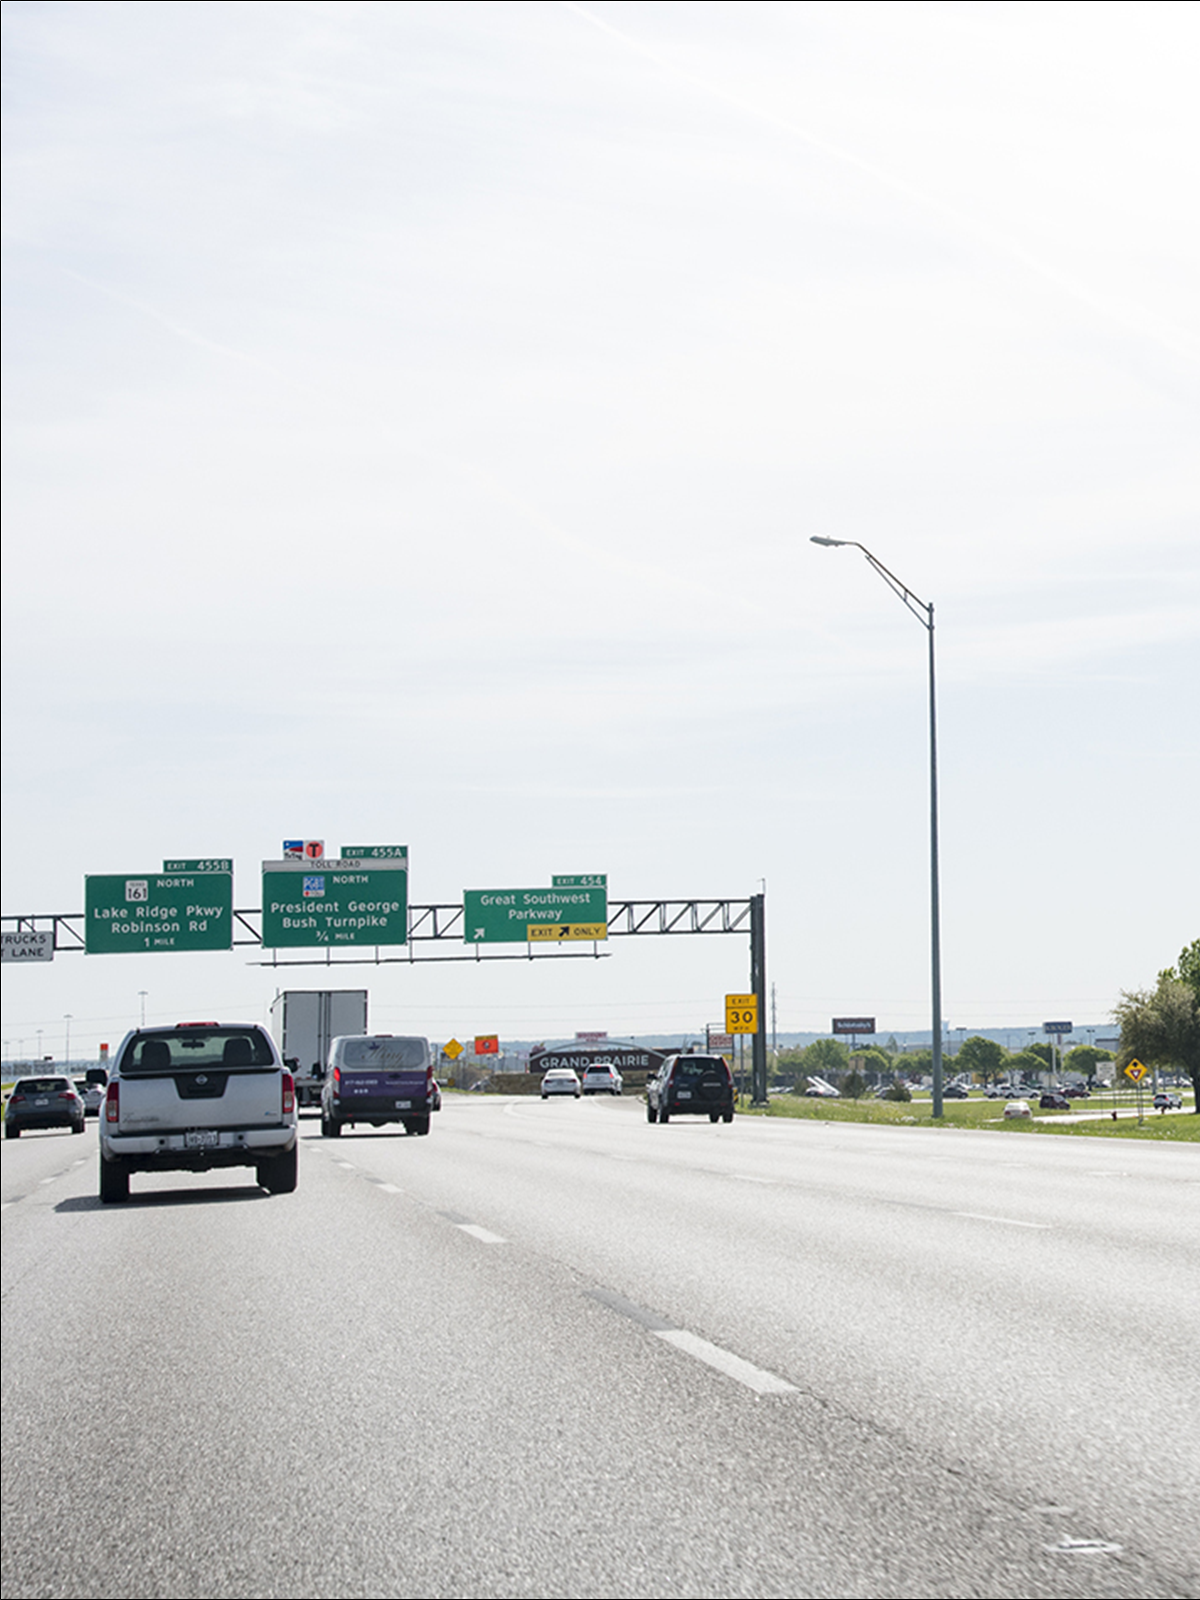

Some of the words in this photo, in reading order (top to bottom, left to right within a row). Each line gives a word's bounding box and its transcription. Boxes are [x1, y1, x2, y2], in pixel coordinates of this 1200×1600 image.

[346, 849, 364, 857] EXIT
[371, 848, 402, 857] 455A
[167, 862, 186, 870] EXIT
[197, 860, 229, 871] 455B
[311, 861, 332, 869] TOLL
[336, 860, 361, 868] ROAD
[156, 879, 194, 888] NORTH
[333, 875, 369, 884] NORTH
[580, 876, 602, 886] 454
[128, 888, 147, 899] 161
[480, 894, 516, 906] Great
[523, 893, 590, 905] Southwest
[94, 907, 128, 919] Lake
[136, 906, 178, 919] Ridge
[186, 905, 223, 919] Pkwy
[271, 901, 339, 913] President
[348, 901, 399, 914] George
[508, 909, 563, 921] Parkway
[111, 921, 180, 933] Robinson
[189, 920, 208, 931] Rd
[282, 916, 317, 928] Bush
[325, 915, 388, 929] Turnpike
[531, 928, 553, 937] EXIT
[573, 927, 602, 936] ONLY
[144, 938, 150, 947] 1
[154, 938, 175, 946] MILE
[12, 947, 44, 957] LANE
[731, 1011, 753, 1024] 30
[539, 1057, 590, 1069] GRAND
[593, 1054, 649, 1067] PRAIRIE
